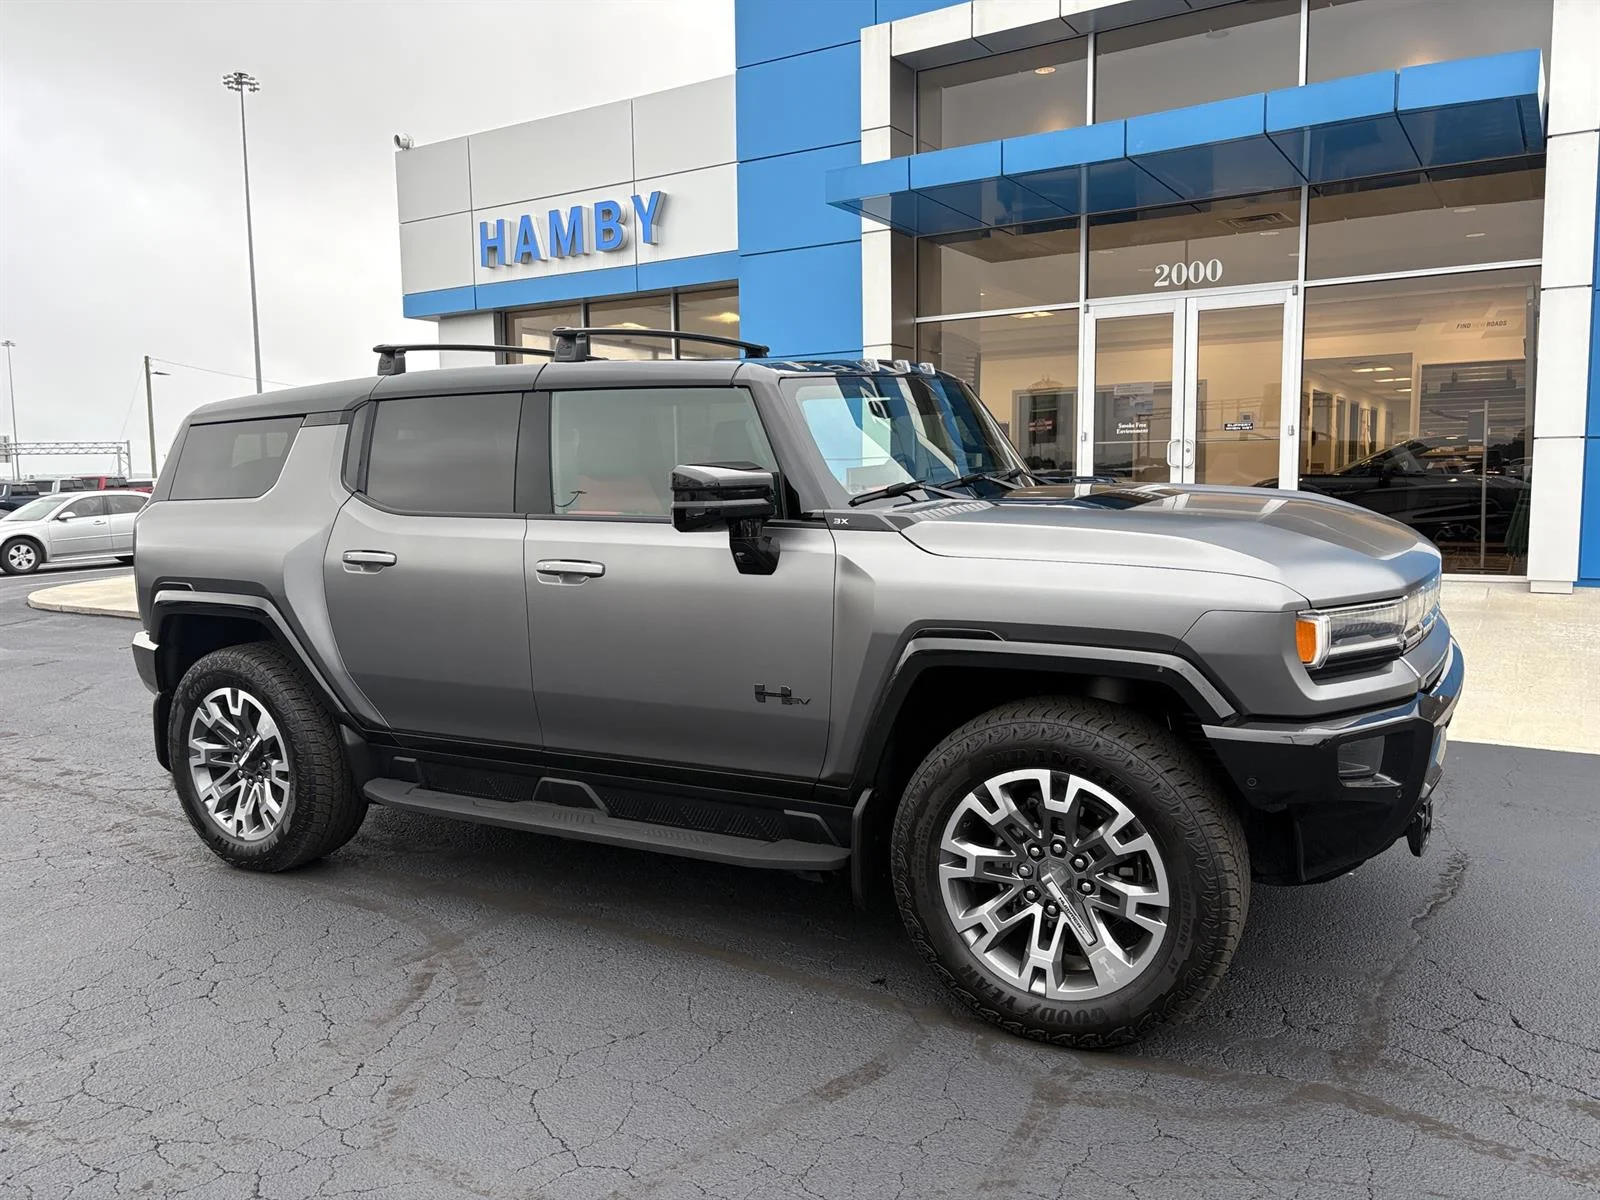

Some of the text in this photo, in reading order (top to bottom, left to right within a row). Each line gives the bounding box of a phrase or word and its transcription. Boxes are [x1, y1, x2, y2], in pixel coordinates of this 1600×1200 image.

[480, 191, 667, 268] HAMBY
[1153, 258, 1223, 287] 2000
[833, 517, 849, 525] 3X
